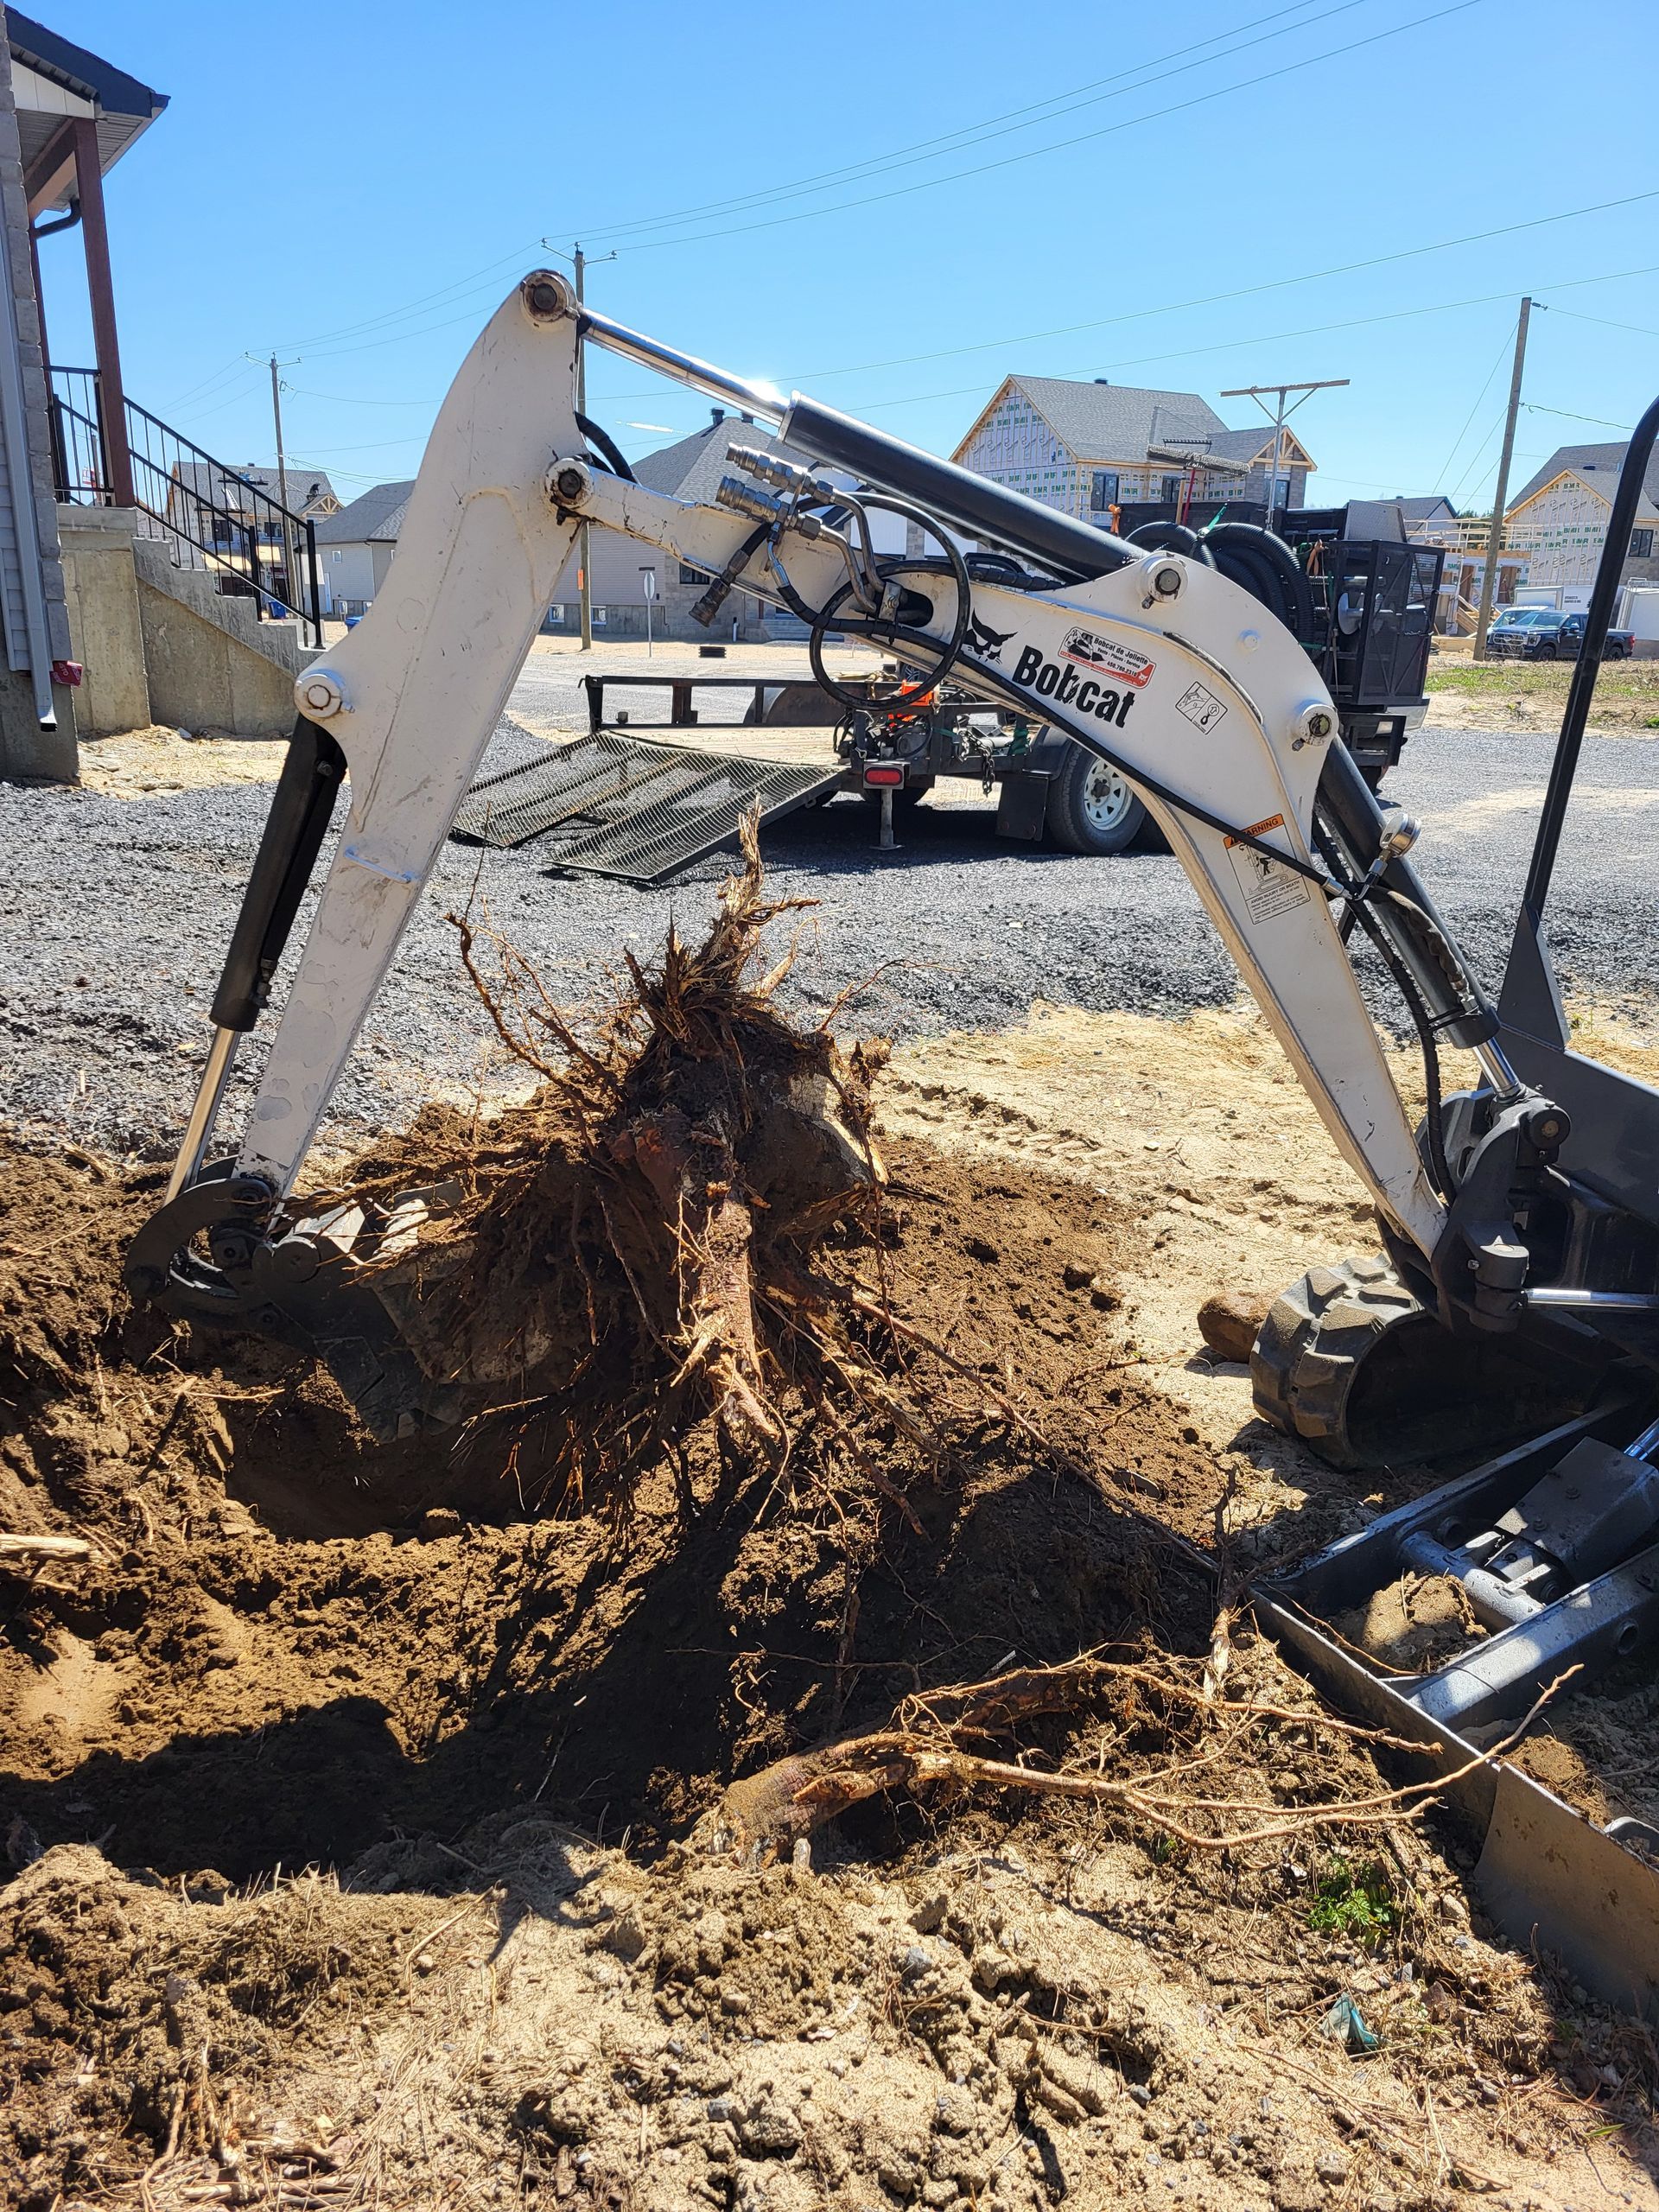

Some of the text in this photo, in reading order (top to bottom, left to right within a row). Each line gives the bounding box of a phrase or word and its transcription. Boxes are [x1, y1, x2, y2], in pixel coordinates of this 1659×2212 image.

[1093, 638, 1116, 651] Bobcat
[1125, 651, 1148, 664] Joliette
[1012, 645, 1135, 728] Bobcat
[1247, 818, 1279, 836] ARNING
